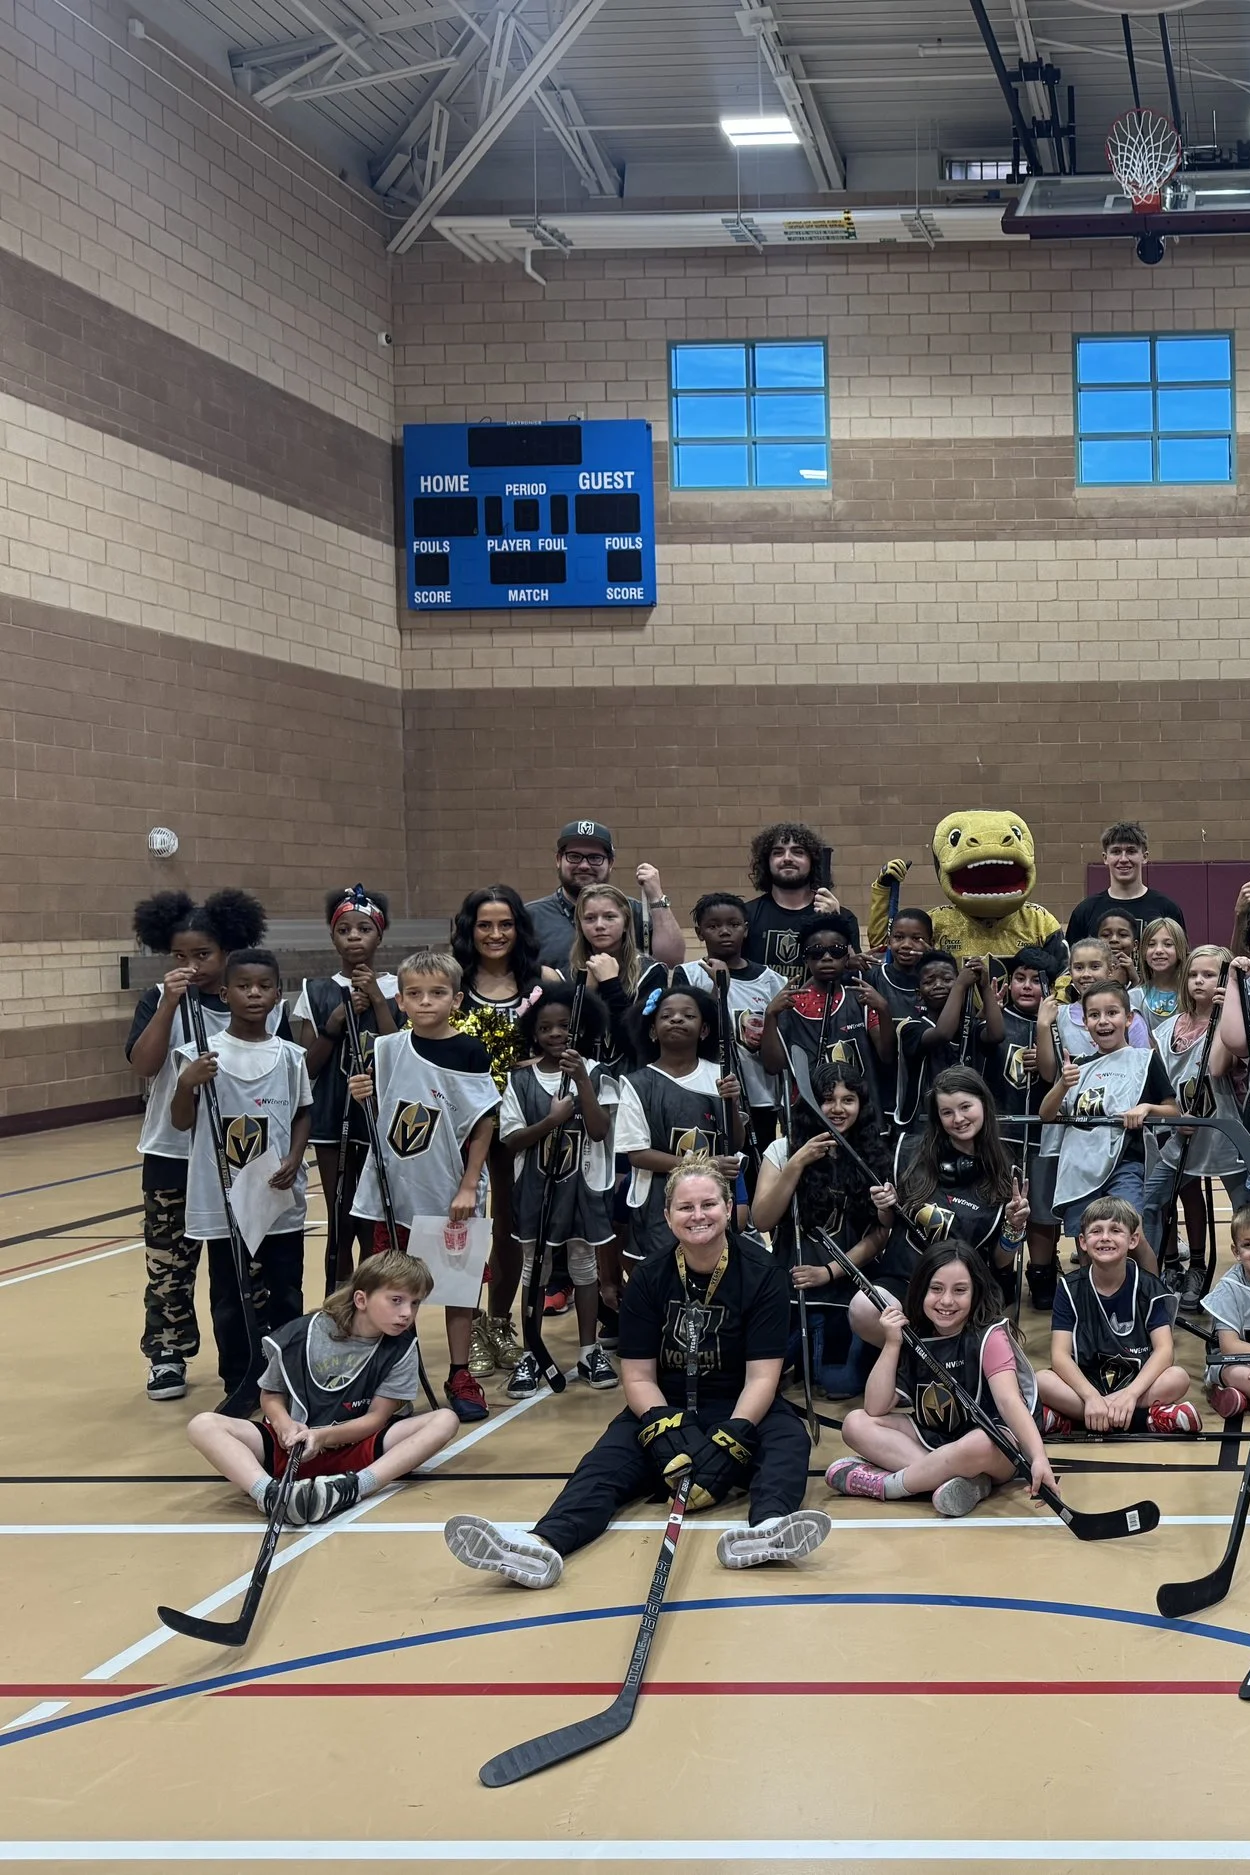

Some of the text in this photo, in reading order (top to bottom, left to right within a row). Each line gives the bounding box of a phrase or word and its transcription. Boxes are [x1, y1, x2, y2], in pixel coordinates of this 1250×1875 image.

[420, 475, 469, 493] HOME
[578, 471, 634, 490] GUEST
[505, 483, 546, 496] PERIOD
[413, 541, 450, 553] FOULS
[487, 538, 567, 552] PLAYER FOUL
[605, 537, 643, 550] FOULS
[414, 591, 451, 604] SCORE
[508, 589, 549, 602] MATCH
[606, 587, 644, 600] SCORE
[952, 1197, 979, 1211] NVEnergy
[665, 1349, 714, 1366] YOTH
[915, 1344, 928, 1360] VEGAS
[641, 1560, 671, 1630] BAUER
